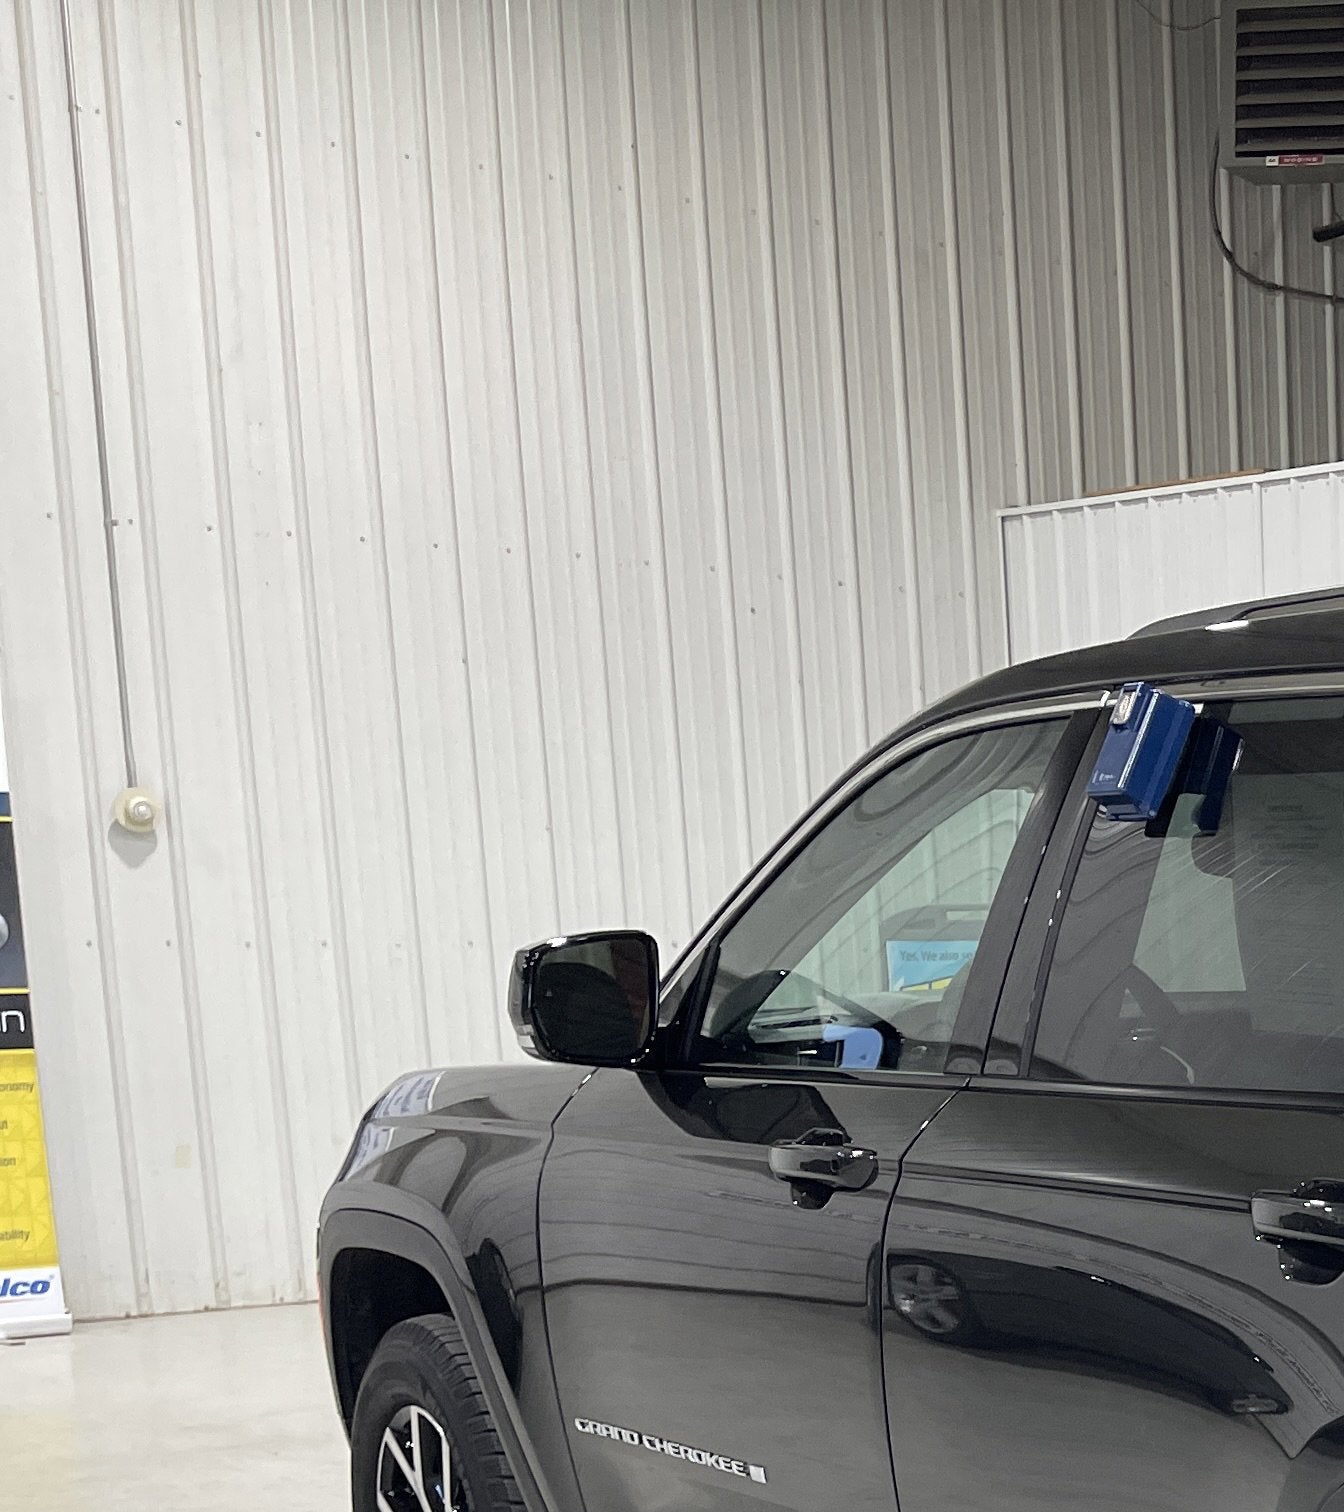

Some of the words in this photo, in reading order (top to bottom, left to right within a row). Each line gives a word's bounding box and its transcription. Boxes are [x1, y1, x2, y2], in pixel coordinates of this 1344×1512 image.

[0, 1277, 51, 1297] lco
[574, 1417, 640, 1446] GRAND
[641, 1434, 748, 1477] CHEROKEE
